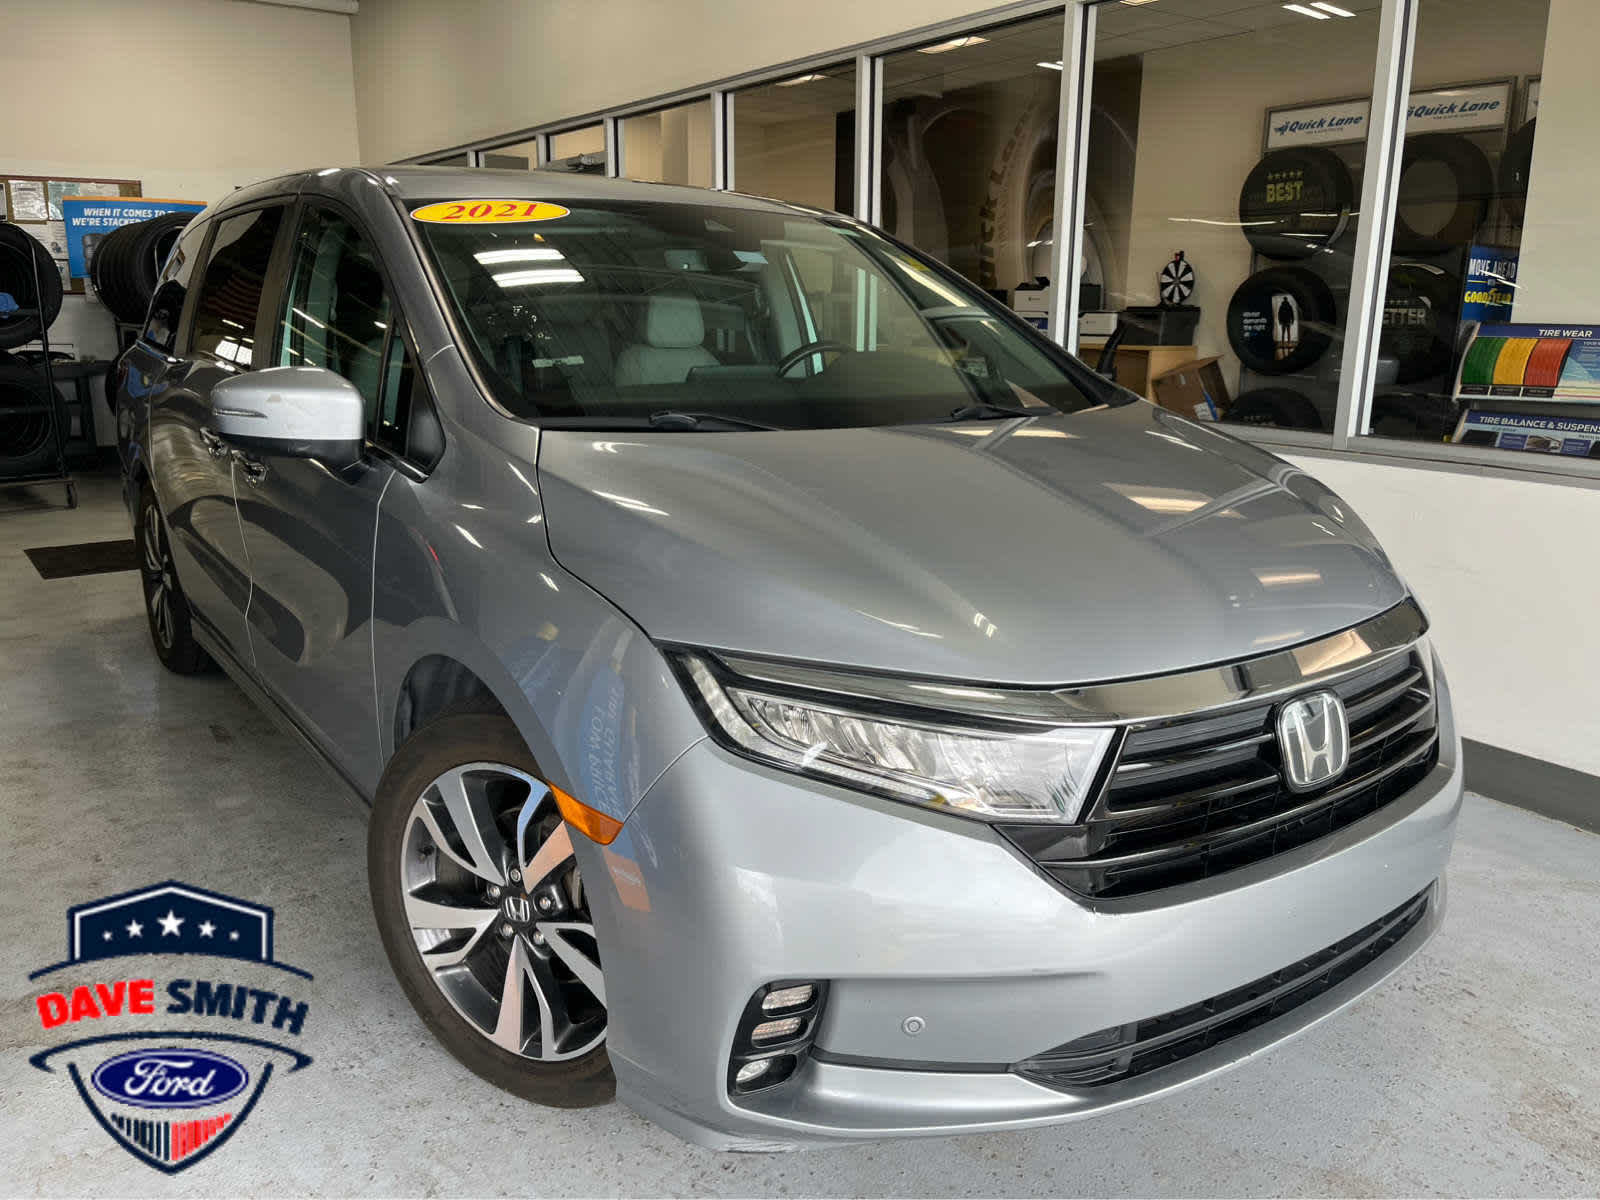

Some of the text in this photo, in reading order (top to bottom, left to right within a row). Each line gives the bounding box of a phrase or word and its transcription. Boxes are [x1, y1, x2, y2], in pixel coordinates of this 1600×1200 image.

[1411, 102, 1456, 118] Quick
[1460, 99, 1500, 113] Lane
[1287, 120, 1325, 133] Quick
[1328, 115, 1364, 128] Lane
[1266, 180, 1304, 204] BEST
[83, 207, 111, 217] WHEN
[112, 208, 121, 217] IT
[122, 208, 152, 218] COMES
[441, 203, 537, 219] 2021
[72, 217, 101, 227] WE'RE
[1468, 258, 1516, 278] MOVE AHEAD
[1383, 307, 1426, 325] ETTER
[1538, 329, 1593, 338] TIRE WEAR
[1480, 416, 1501, 425] TIRE
[1501, 417, 1546, 428] BALANCE
[1547, 421, 1555, 429] &
